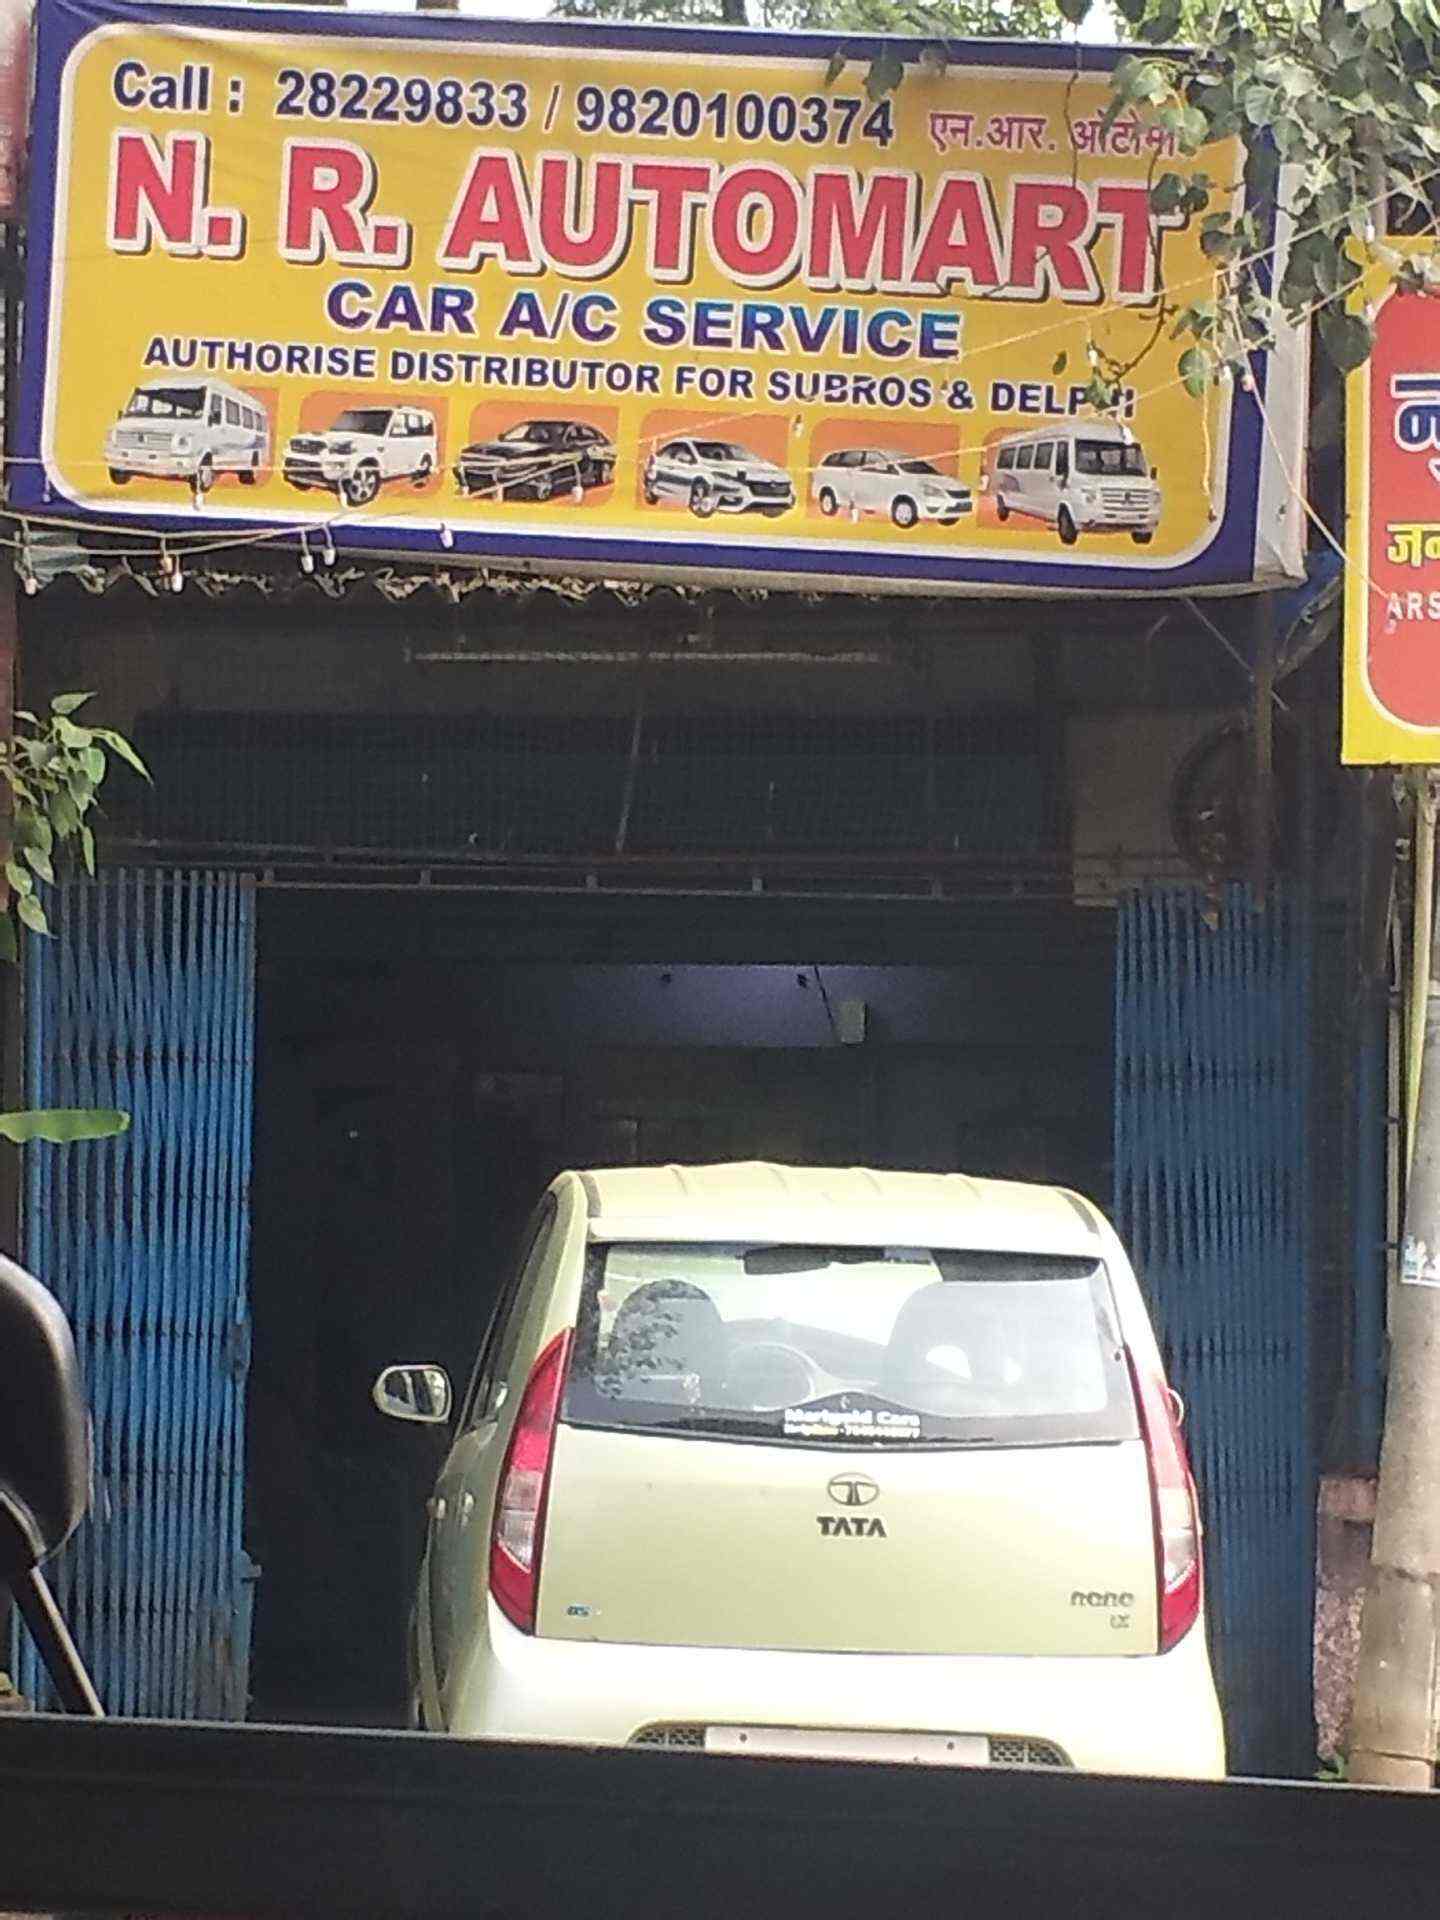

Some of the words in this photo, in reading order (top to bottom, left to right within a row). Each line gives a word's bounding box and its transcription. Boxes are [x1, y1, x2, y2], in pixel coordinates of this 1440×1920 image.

[113, 60, 210, 111] Call
[275, 69, 528, 128] 28229833
[576, 85, 894, 149] 9820100374
[111, 132, 239, 252] N.
[283, 143, 406, 261] R.
[438, 150, 1182, 303] AUTOMART
[326, 281, 476, 334] CAR
[500, 292, 618, 344] A/C
[643, 298, 962, 360] SERVICE
[146, 337, 376, 378] AUTHORISE
[390, 350, 660, 393] DISTRIBUTOR
[675, 365, 754, 398] FOR
[768, 370, 932, 409] SUBROS
[946, 379, 974, 410] &
[816, 1516, 887, 1538] TATA
